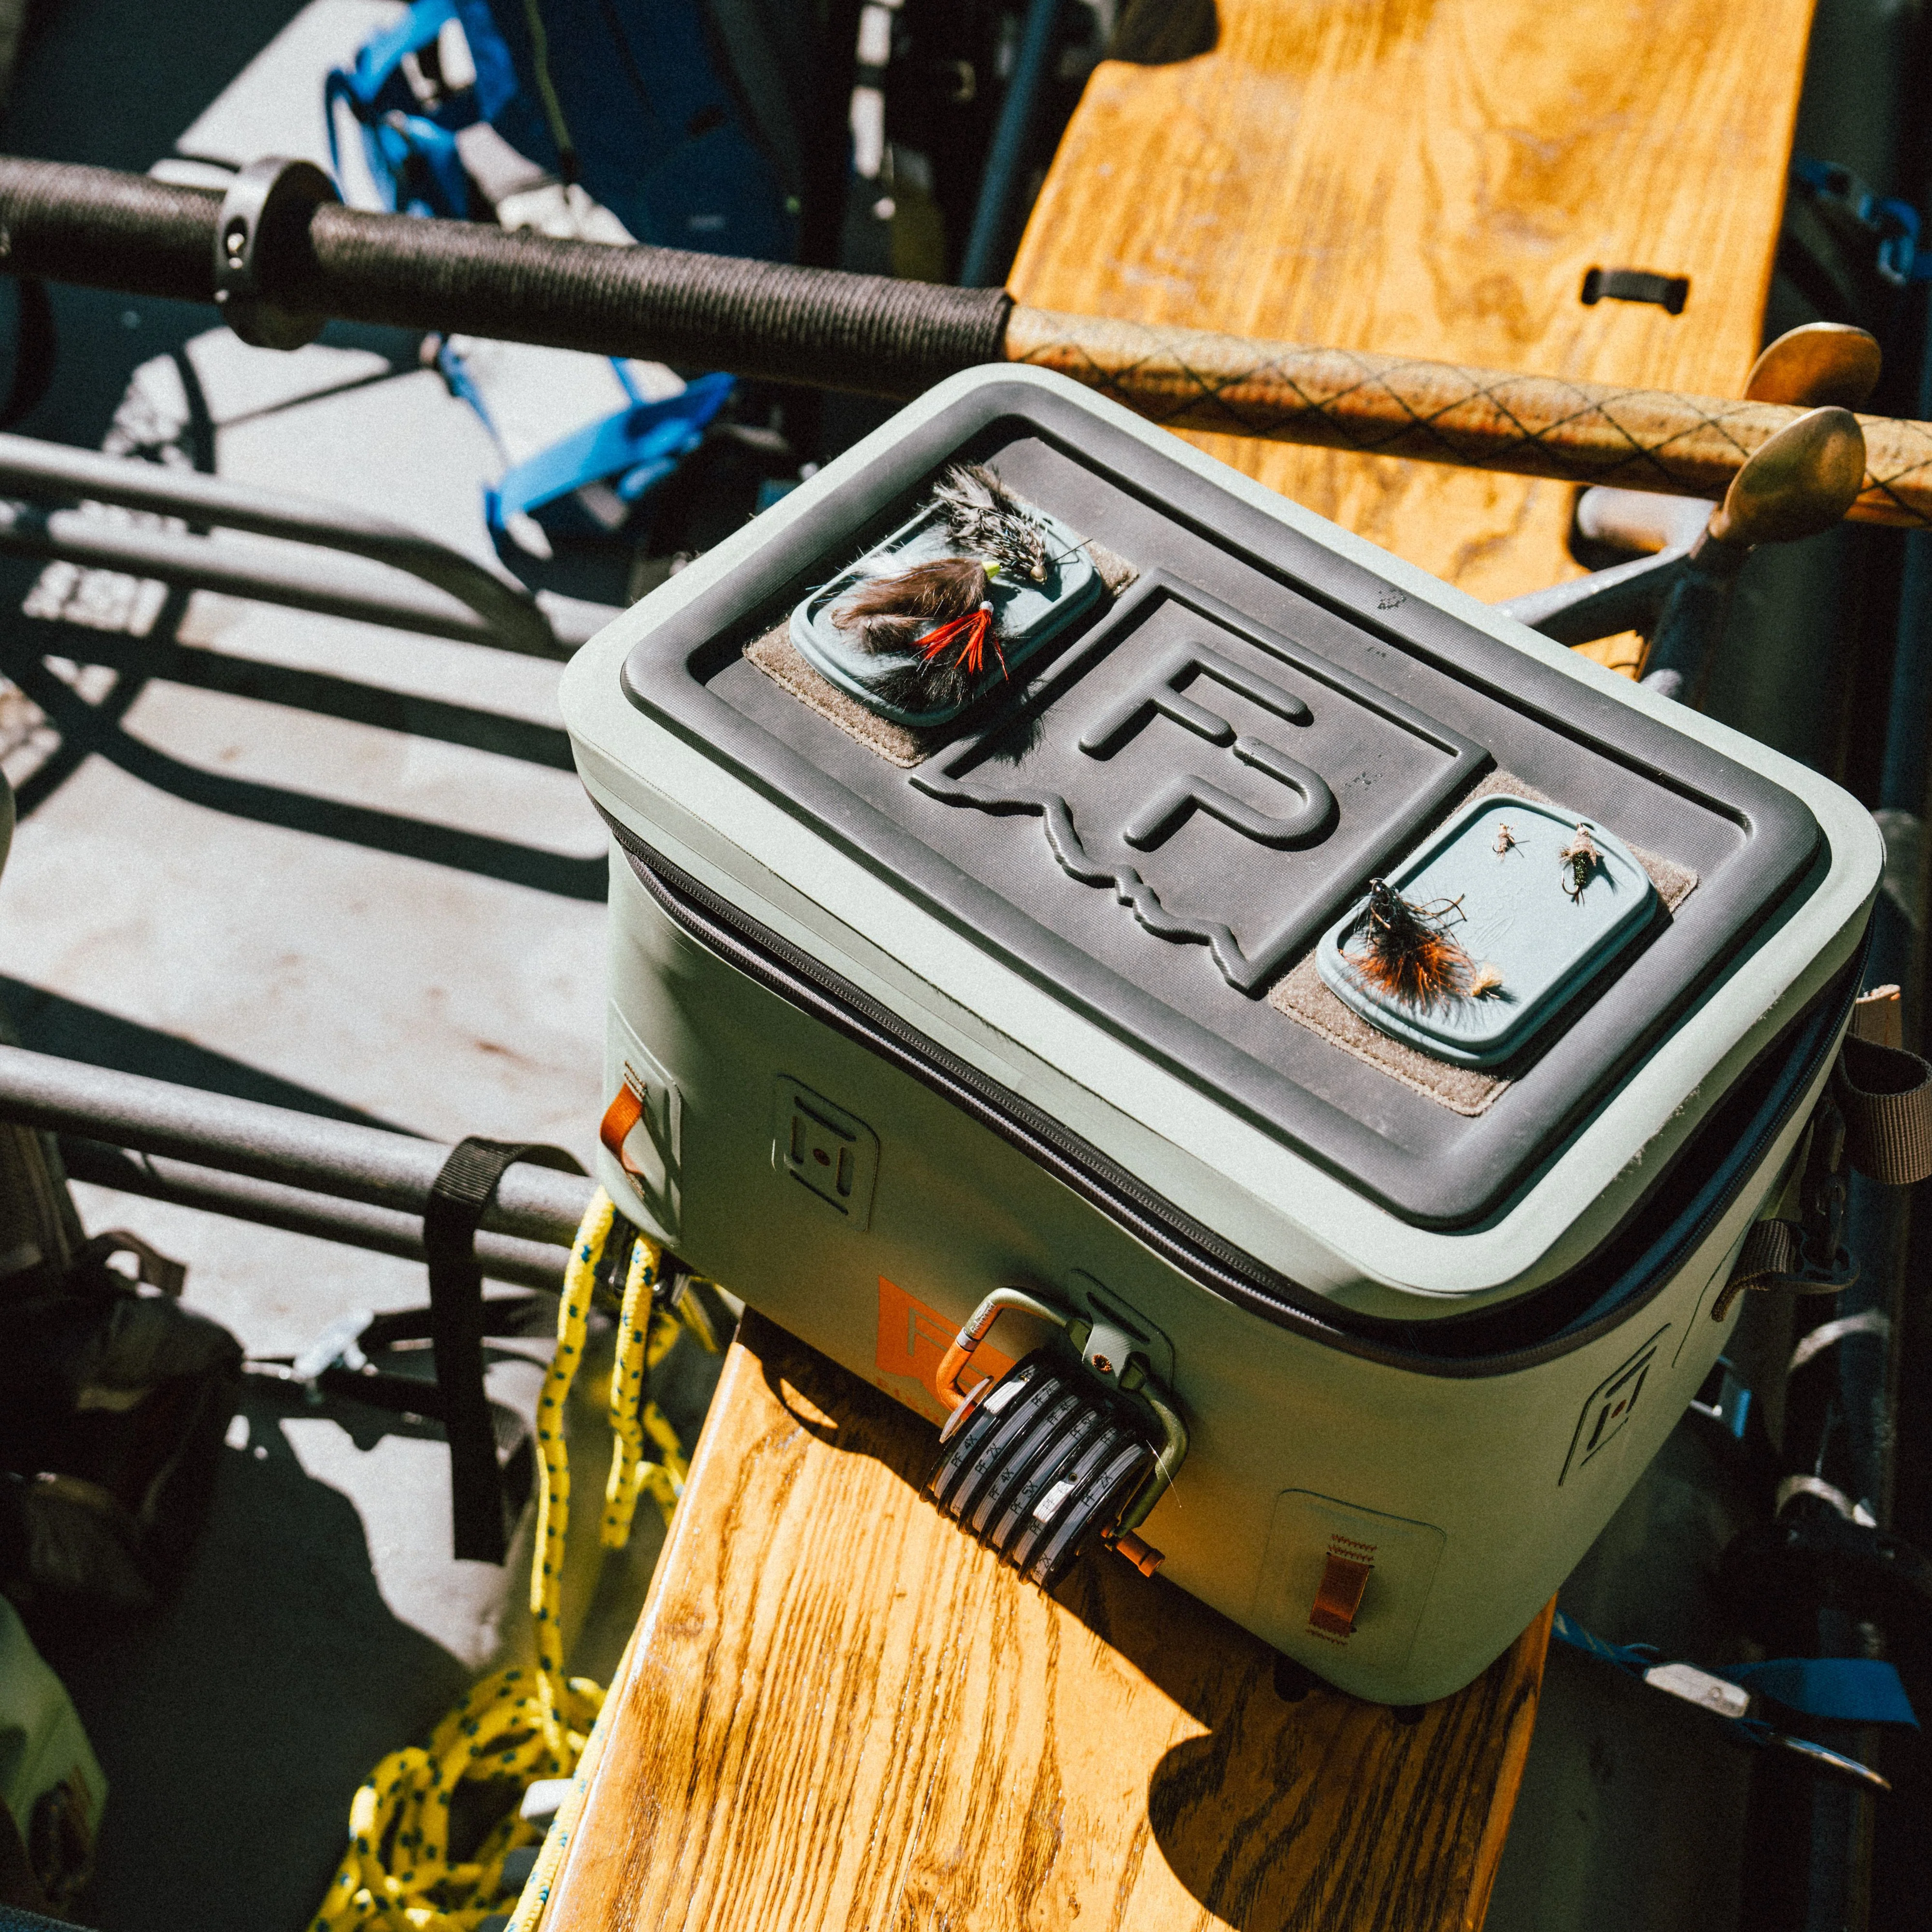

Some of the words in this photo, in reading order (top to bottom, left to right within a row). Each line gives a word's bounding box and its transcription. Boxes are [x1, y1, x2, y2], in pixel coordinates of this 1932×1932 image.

[969, 1299, 998, 1336] fishpond
[1031, 1394, 1043, 1406] PF
[1047, 1414, 1058, 1425] PF
[1070, 1428, 1082, 1440] PF
[951, 1451, 963, 1467] PF
[964, 1435, 978, 1449] 4X
[975, 1459, 988, 1475] PF
[989, 1484, 1000, 1500] PF
[1001, 1467, 1014, 1483] 4X
[1081, 1488, 1095, 1507] PF
[1096, 1472, 1113, 1490] 2X
[1010, 1498, 1023, 1514] PF
[1022, 1480, 1038, 1498] 5X
[1029, 1519, 1042, 1536] PF
[1039, 1552, 1052, 1569] 2X
